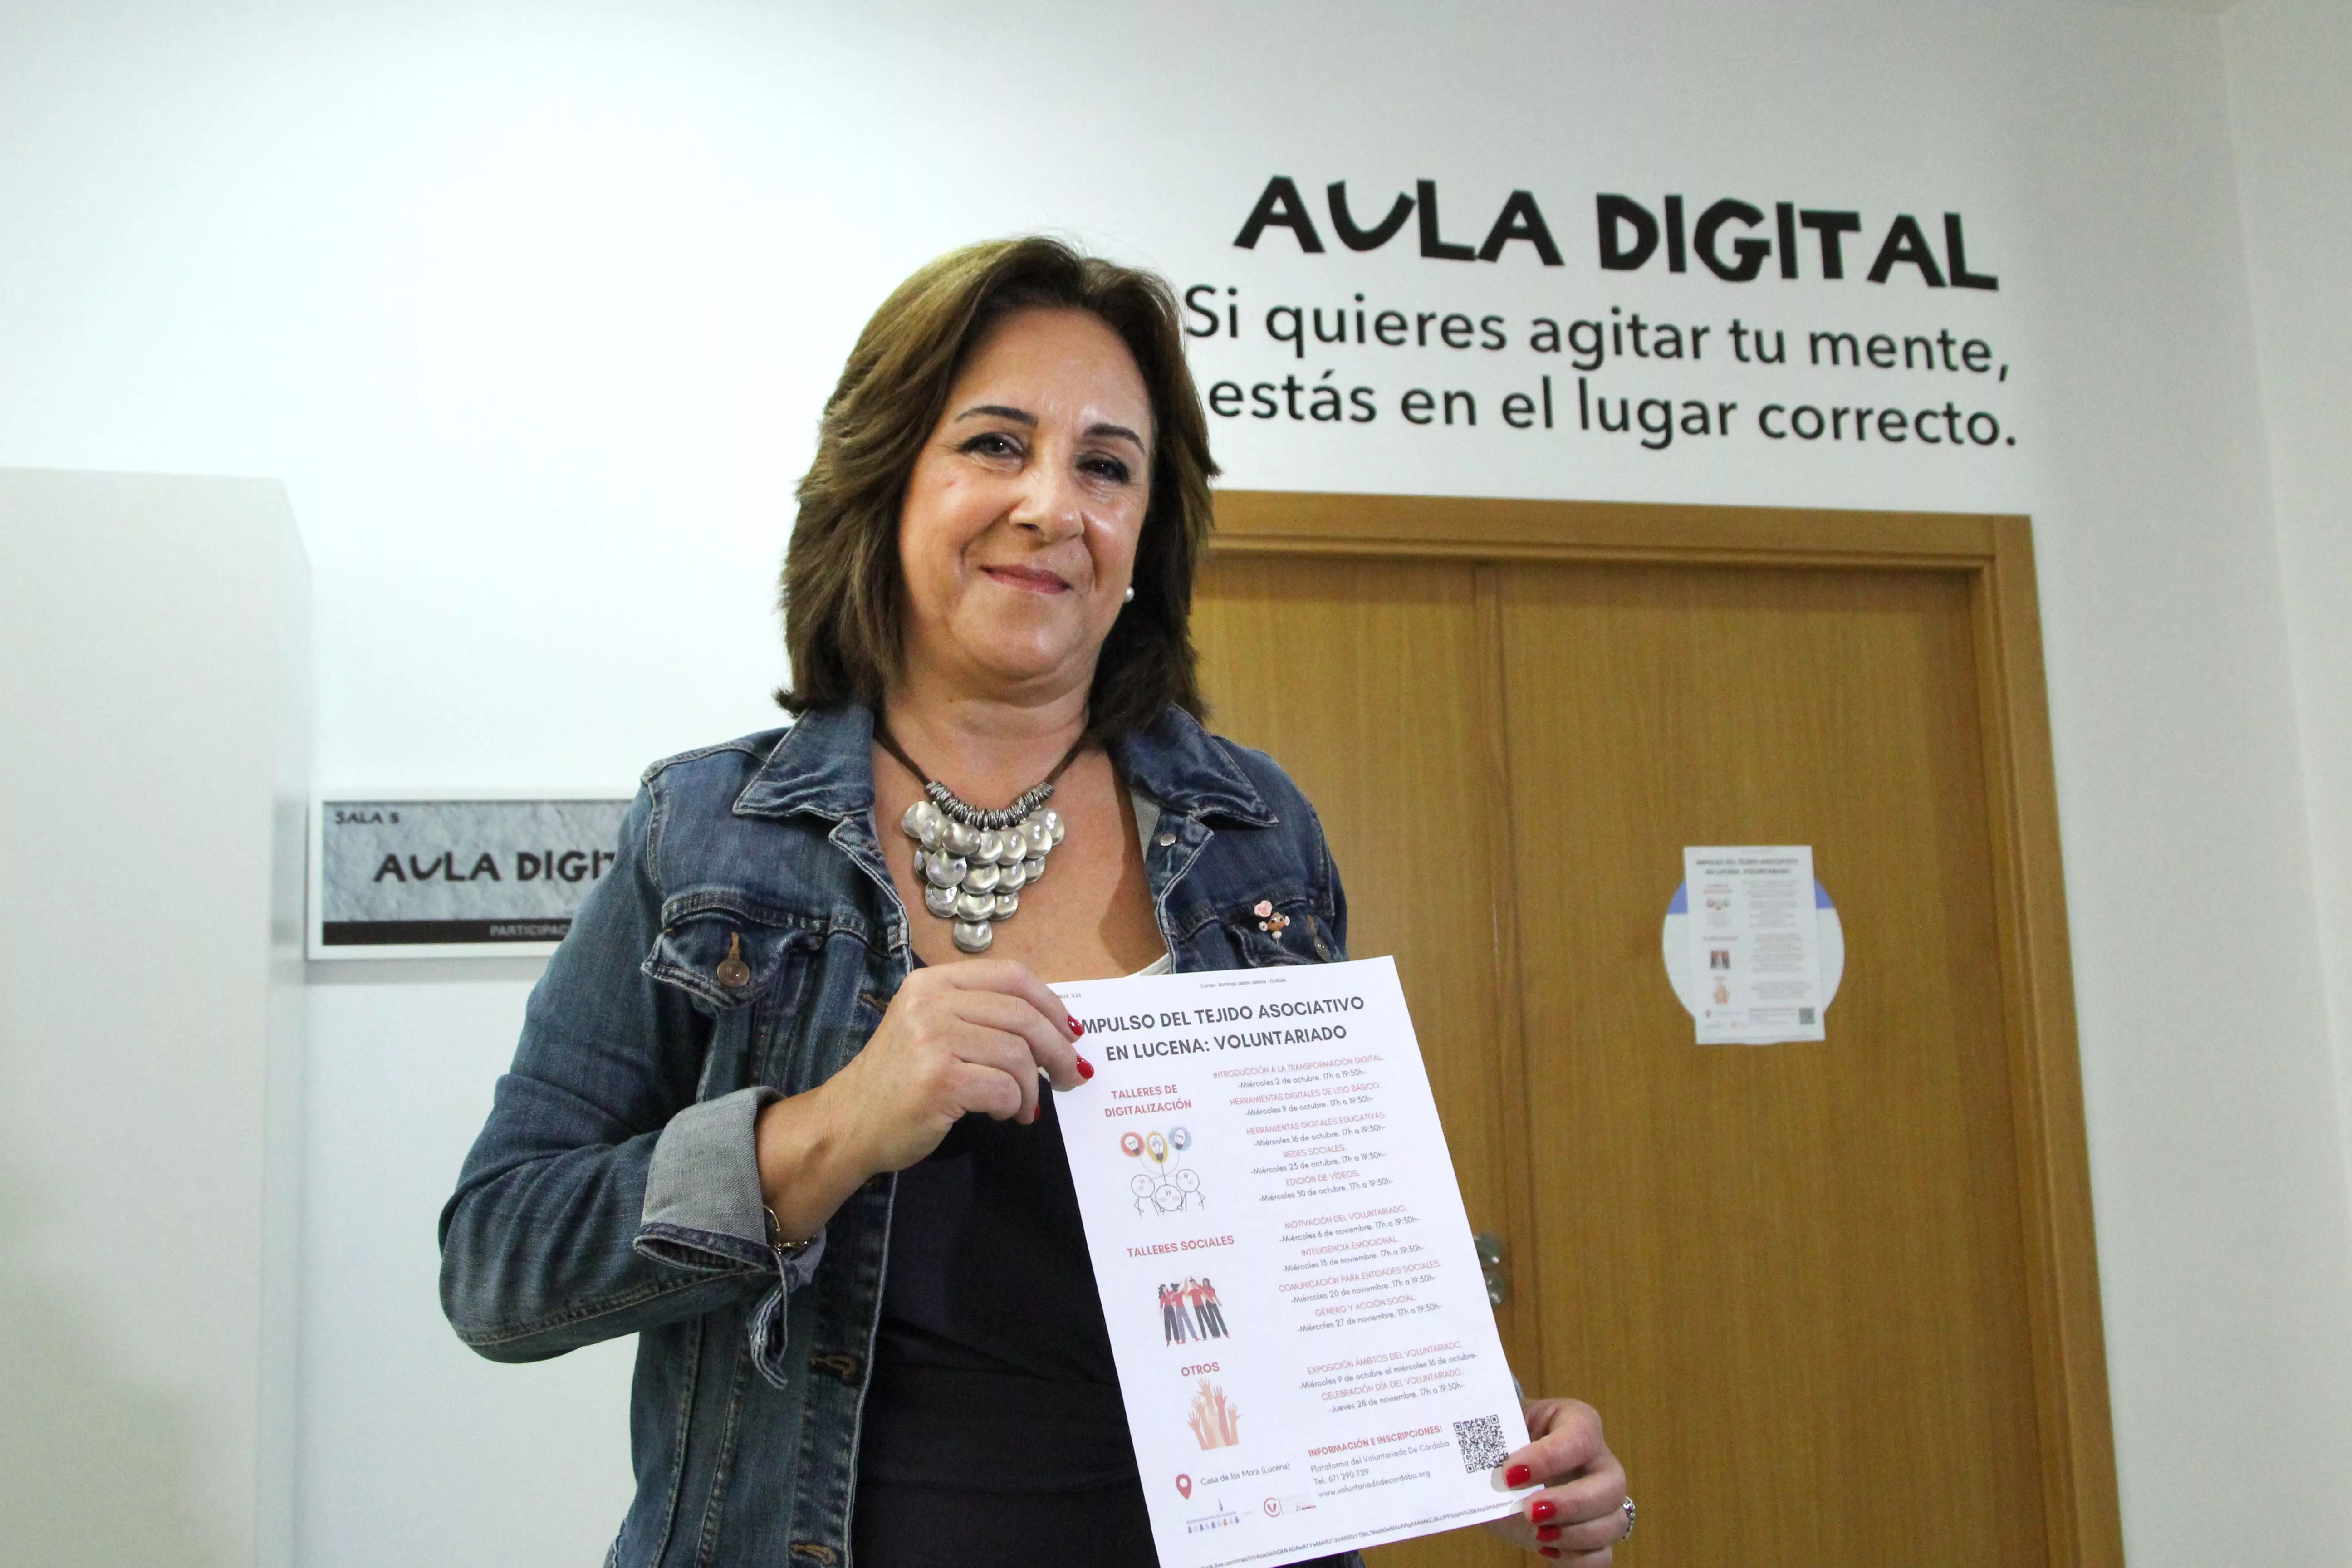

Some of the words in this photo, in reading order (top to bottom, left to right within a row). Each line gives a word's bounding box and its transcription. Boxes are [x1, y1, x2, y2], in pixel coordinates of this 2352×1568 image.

[1233, 175, 1564, 267] AULA
[1596, 193, 1999, 291] DIGITAL
[1183, 284, 1238, 338] Si
[1265, 293, 1507, 359] quieres
[1530, 306, 1710, 372] agitar
[1728, 319, 1786, 364] tu
[1809, 329, 2009, 382] mente,
[1209, 369, 1377, 423] estás
[1401, 388, 1476, 426] en
[1502, 375, 1553, 429] el
[1578, 377, 1737, 450] lugar
[1759, 402, 2016, 446] correcto.
[335, 811, 383, 825] SALA
[373, 851, 500, 882] AULA
[1078, 1014, 1155, 1034] MPULSO
[1160, 1011, 1191, 1028] DEL
[1194, 1006, 1253, 1024] TEJIDO
[1259, 996, 1364, 1019] ASOCIATIVO
[1106, 1045, 1129, 1061] EN
[1133, 1038, 1210, 1058] LUCENA:
[1213, 1025, 1347, 1050] VOLUNTARIADO
[1212, 1065, 1269, 1078] INTRODUCCIÓN
[1287, 1057, 1353, 1071] TRANSFORMACIÓN
[1110, 1086, 1162, 1099] TALLERES
[1164, 1084, 1178, 1094] DE
[1238, 1078, 1274, 1088] -Miércoles
[1322, 1072, 1334, 1080] 17h
[1229, 1094, 1283, 1106] HERRAMIENTAS
[1284, 1089, 1321, 1100] DIGITALES
[1322, 1088, 1333, 1096] DE
[1333, 1085, 1351, 1095] USO
[1104, 1098, 1192, 1117] DIGITALIZACIÓN
[1245, 1107, 1281, 1116] -Miércoles
[1288, 1103, 1298, 1112] de
[1246, 1122, 1300, 1136] HERRAMIENTAS
[1300, 1118, 1338, 1129] DIGITALES
[1254, 1136, 1290, 1147] -Miércoles
[1291, 1135, 1299, 1143] 16
[1300, 1133, 1310, 1142] de
[1341, 1127, 1353, 1136] 17h
[1250, 1164, 1288, 1175] -Miércoles
[1288, 1162, 1298, 1171] 23
[1299, 1161, 1310, 1169] de
[1341, 1155, 1353, 1163] 17h
[1283, 1149, 1307, 1158] REDES
[1285, 1175, 1317, 1186] EDICIÓN
[1317, 1173, 1328, 1182] DE
[1259, 1191, 1295, 1202] -Miércoles
[1296, 1189, 1306, 1197] 30
[1307, 1188, 1317, 1196] de
[1348, 1182, 1361, 1190] 17h
[1279, 1232, 1317, 1243] -Miércoles
[1324, 1229, 1333, 1237] de
[1374, 1220, 1387, 1229] 17h
[1284, 1215, 1332, 1230] MOTIVACIÓN
[1333, 1214, 1348, 1223] DEL
[1126, 1242, 1178, 1258] TALLERES
[1180, 1235, 1235, 1251] SOCIALES
[1282, 1261, 1319, 1272] -Miércoles
[1329, 1258, 1339, 1266] de
[1380, 1249, 1392, 1257] 17h
[1278, 1275, 1340, 1293] COMUNICACIÓN
[1340, 1274, 1361, 1283] PARA
[1361, 1266, 1402, 1280] ENTIDADES
[1291, 1292, 1328, 1303] -Miércoles
[1328, 1289, 1339, 1298] 20
[1341, 1288, 1351, 1296] de
[1392, 1279, 1404, 1288] 17h
[1315, 1305, 1347, 1317] GÉNERO
[1355, 1298, 1386, 1311] ACCIÓN
[1297, 1321, 1334, 1333] -Miércoles
[1335, 1318, 1344, 1327] 27
[1346, 1317, 1356, 1325] de
[1397, 1307, 1409, 1316] 17h
[1181, 1362, 1220, 1377] OTROS
[1299, 1377, 1337, 1390] -Miércoles
[1344, 1373, 1354, 1382] de
[1355, 1370, 1383, 1380] octubre
[1385, 1366, 1392, 1375] al
[1393, 1361, 1427, 1373] miércoles
[1437, 1357, 1447, 1365] de
[1306, 1359, 1354, 1375] EXPOSICIÓN
[1356, 1354, 1388, 1367] ÁMBITOS
[1389, 1352, 1404, 1361] DEL
[1321, 1384, 1374, 1401] CELEBRACIÓN
[1375, 1380, 1389, 1391] DÍA
[1389, 1379, 1404, 1389] DEL
[1328, 1403, 1355, 1413] -Jueves
[1356, 1399, 1367, 1408] 28
[1368, 1397, 1378, 1406] de
[1419, 1387, 1431, 1396] 17h
[1308, 1438, 1370, 1457] INFORMACIÓN
[1370, 1437, 1376, 1446] E
[1377, 1425, 1443, 1444] INSCRIPCIONES:
[1310, 1460, 1349, 1473] Plataforma
[1350, 1456, 1362, 1465] del
[1362, 1448, 1407, 1463] Voluntariado
[1419, 1441, 1450, 1452] Córdoba
[1200, 1477, 1219, 1485] Casa
[1220, 1474, 1230, 1482] de
[1241, 1469, 1260, 1478] Mora
[1261, 1462, 1290, 1475] (Lucena)
[1318, 1472, 1431, 1498] www.voluntariadodecordoba.org
[1328, 1473, 1340, 1483] 671
[1340, 1471, 1355, 1481] 290
[1355, 1468, 1369, 1477] 729
